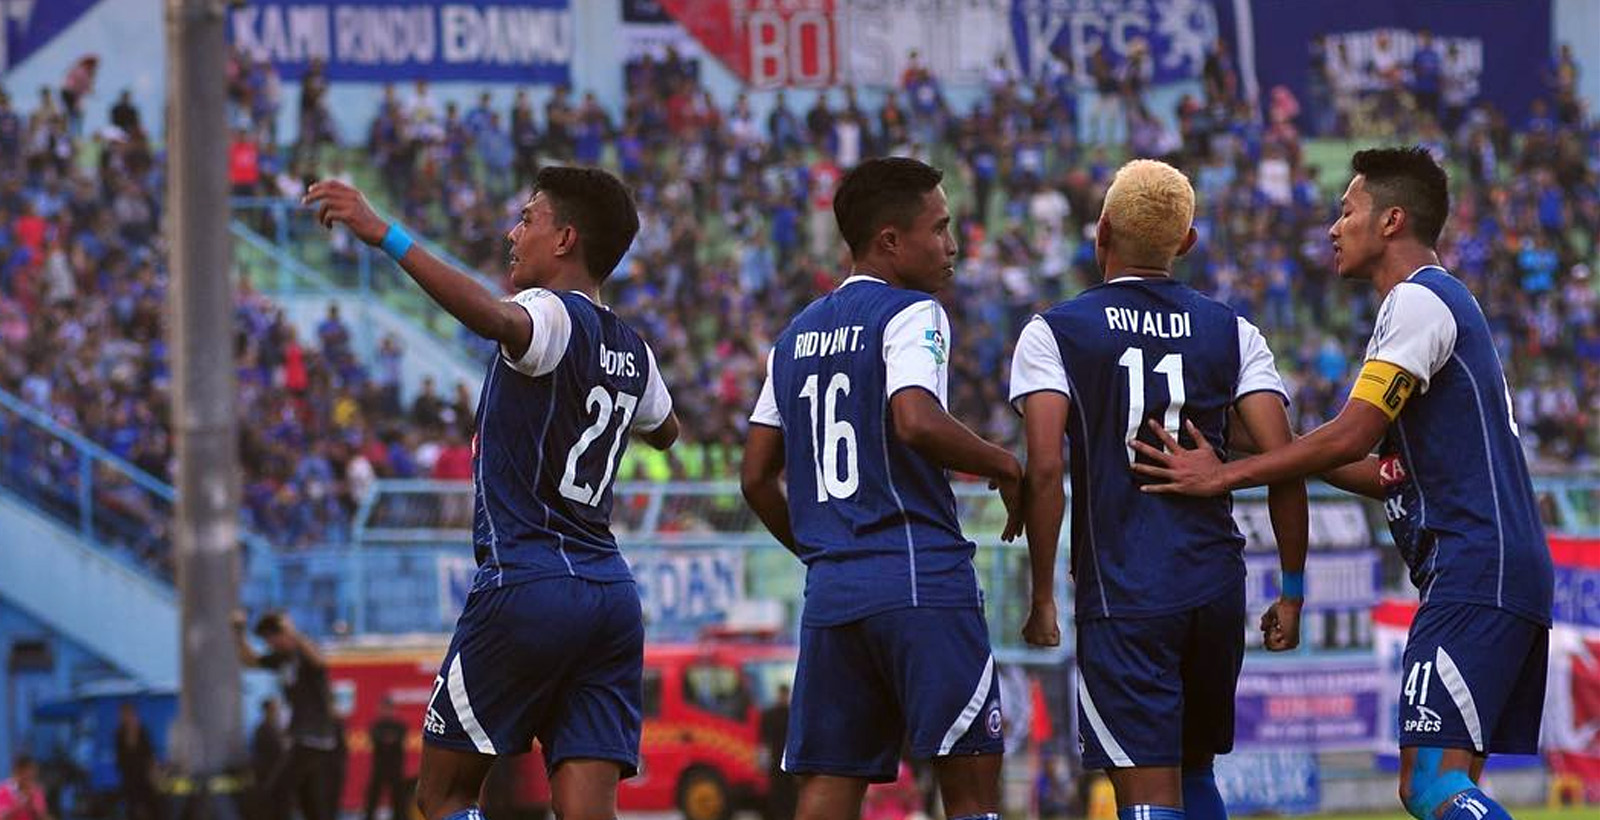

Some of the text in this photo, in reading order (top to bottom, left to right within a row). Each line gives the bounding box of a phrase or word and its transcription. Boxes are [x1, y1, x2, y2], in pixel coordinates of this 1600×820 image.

[1105, 307, 1191, 338] RIVALDI
[794, 327, 848, 360] RIDVAN
[1118, 346, 1185, 467] 11
[1383, 371, 1410, 410] C
[558, 385, 638, 508] 27
[799, 373, 859, 502] 16
[1404, 661, 1432, 705] 41
[1404, 720, 1442, 732] SPECS
